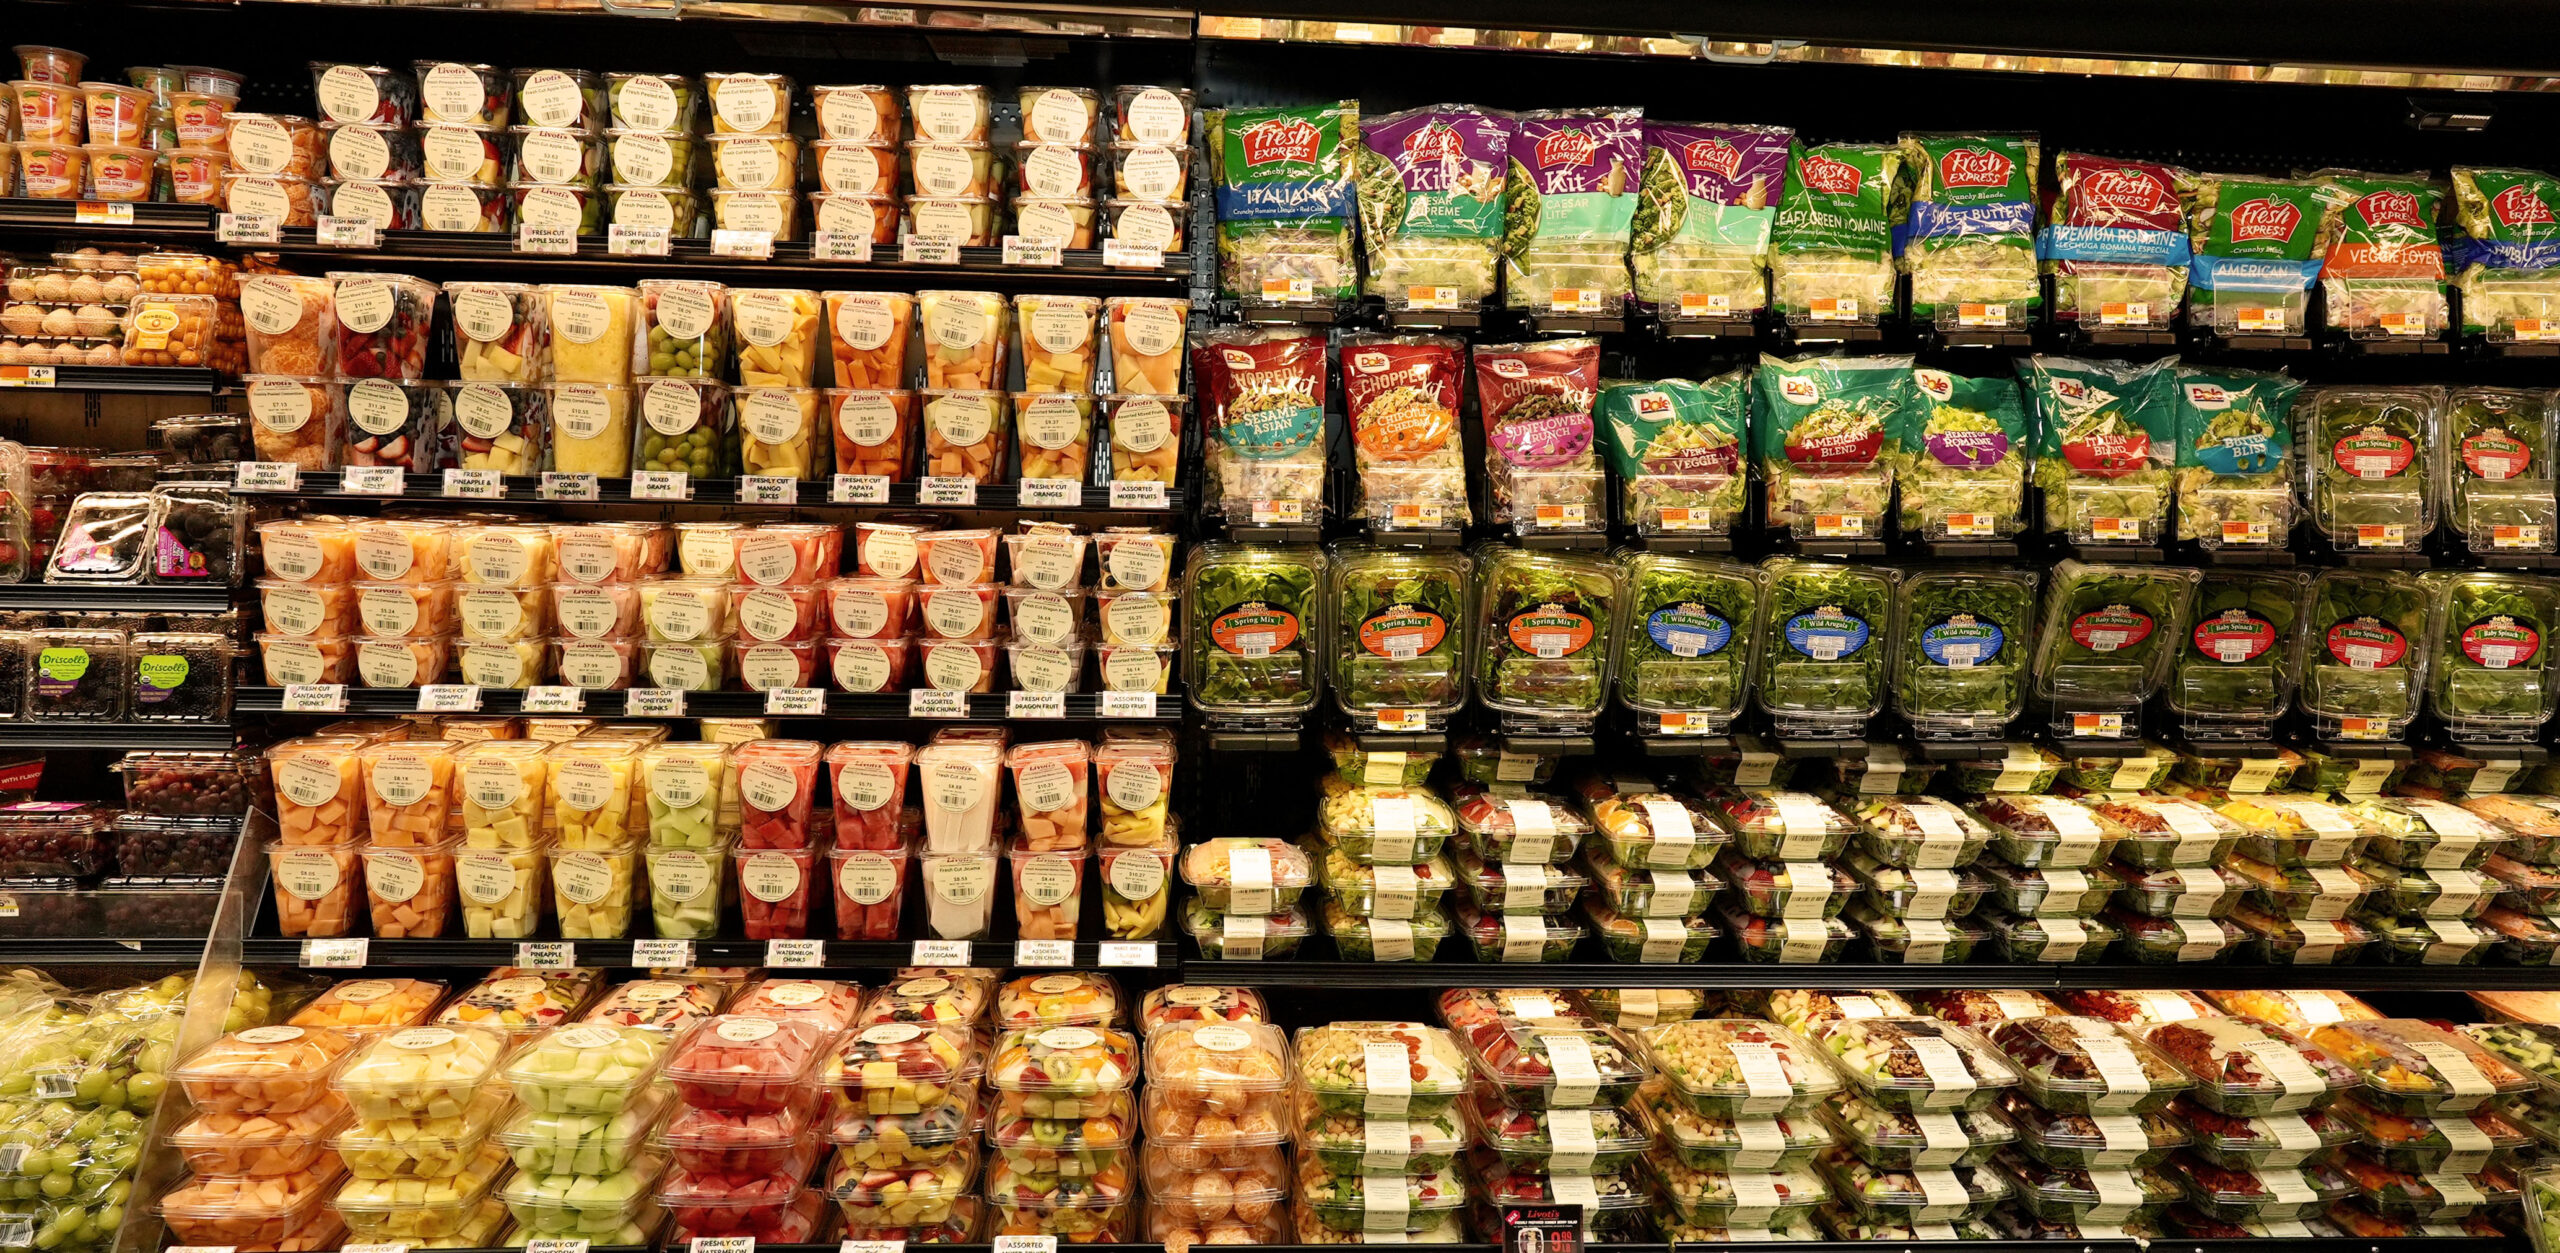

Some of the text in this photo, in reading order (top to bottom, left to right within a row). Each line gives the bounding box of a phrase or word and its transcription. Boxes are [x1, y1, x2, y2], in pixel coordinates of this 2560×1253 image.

[1254, 127, 1311, 148] Fresh
[1544, 135, 1587, 152] Fresh
[1254, 147, 1310, 160] EXPRESS
[1544, 150, 1588, 163] EXPRESS
[1693, 143, 1735, 166] Fresh
[1692, 160, 1731, 178] EXPRESS
[1952, 152, 2003, 173] Fresh
[1544, 172, 1586, 194] Kit
[1949, 171, 2000, 184] EXPRESS
[2094, 172, 2153, 196] Fresh
[1690, 175, 1724, 204] Kit
[1546, 198, 1589, 209] CAESAR
[2093, 194, 2150, 208] EXPRESS
[2368, 198, 2413, 215] Fresh
[1546, 210, 1568, 220] LITE
[1774, 210, 1808, 227] LEAFY
[2241, 203, 2291, 225] Fresh
[2053, 224, 2177, 247] PREMIUM ROMAINE
[2239, 225, 2287, 237] EXPRESS
[630, 238, 646, 246] KIWI
[2059, 242, 2170, 255] LECHUGA ROMANA ESPECIAL
[2350, 249, 2399, 264] VEGGIE
[2217, 264, 2289, 279] AMERICAN
[1227, 353, 1250, 363] Dole
[1362, 357, 1385, 367] Dole
[1499, 362, 1523, 373] Dole
[1787, 381, 1813, 396] Dole
[1921, 374, 1949, 392] Dole
[2059, 381, 2083, 397] Dole
[2193, 387, 2223, 400] Dole
[1640, 397, 1669, 412] Dole
[1243, 406, 1298, 427] SESAME
[1377, 408, 1428, 427] CHIPOTLE
[1254, 418, 1292, 435] ASIAN
[1504, 414, 1586, 439] SUNFLOWER
[1804, 431, 1869, 450] AMERICAN
[1944, 436, 1994, 448] ROMAINE
[1945, 430, 1976, 441] HEARTS
[2085, 434, 2127, 448] ITALIAN
[2225, 435, 2266, 449] BUTTER
[1821, 444, 1857, 458] BLEND
[2094, 445, 2127, 457] BLEND
[2355, 440, 2392, 449] Baby Spinach
[2478, 441, 2510, 451] Baby Spinach
[1681, 447, 1707, 458] VERY
[2232, 446, 2267, 458] BLISS
[1674, 454, 1719, 470] VEGGIE
[1234, 615, 1275, 627] Spring Mix
[1382, 618, 1422, 630] Spring Mix
[1531, 618, 1571, 629] Spring Mix
[1671, 615, 1711, 629] Wild Arugula
[1809, 619, 1849, 631] Wild Arugula
[2095, 616, 2133, 626] Baby Spinach
[1942, 629, 1982, 638] Wild Arugula
[2216, 623, 2253, 633] Baby Spinach
[2483, 629, 2519, 640] Baby Spinach
[2348, 629, 2385, 641] Baby Spinach
[42, 654, 87, 665] Driscoll's
[142, 662, 186, 673] Driscoll's
[1, 776, 18, 784] WITH
[1527, 1209, 1560, 1219] Livoti's
[1007, 1241, 1044, 1249] ASSORTED
